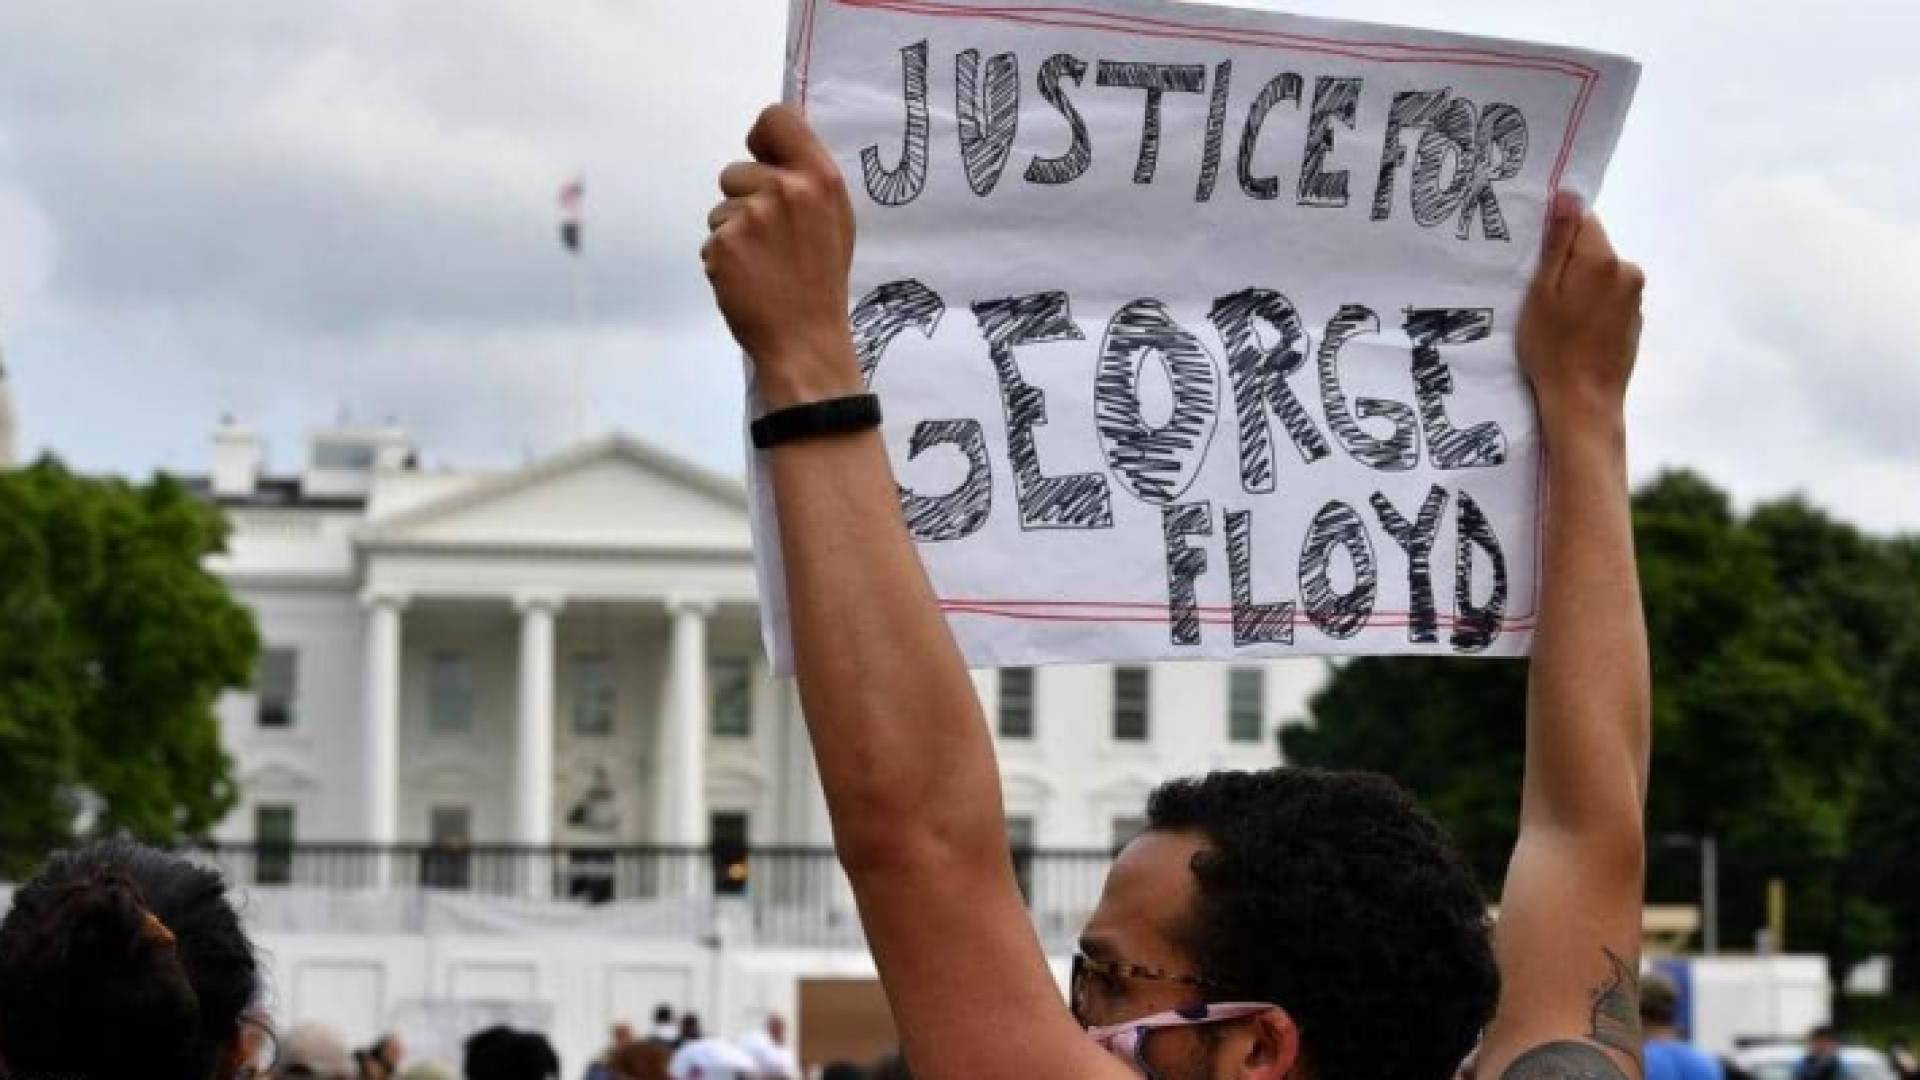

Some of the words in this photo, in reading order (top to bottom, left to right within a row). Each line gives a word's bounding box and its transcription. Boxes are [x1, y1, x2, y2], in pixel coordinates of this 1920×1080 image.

[860, 39, 1364, 208] JUSTICE
[1370, 87, 1529, 242] FOR
[850, 279, 1506, 541] GEORGE
[1162, 484, 1508, 653] FLOYD
